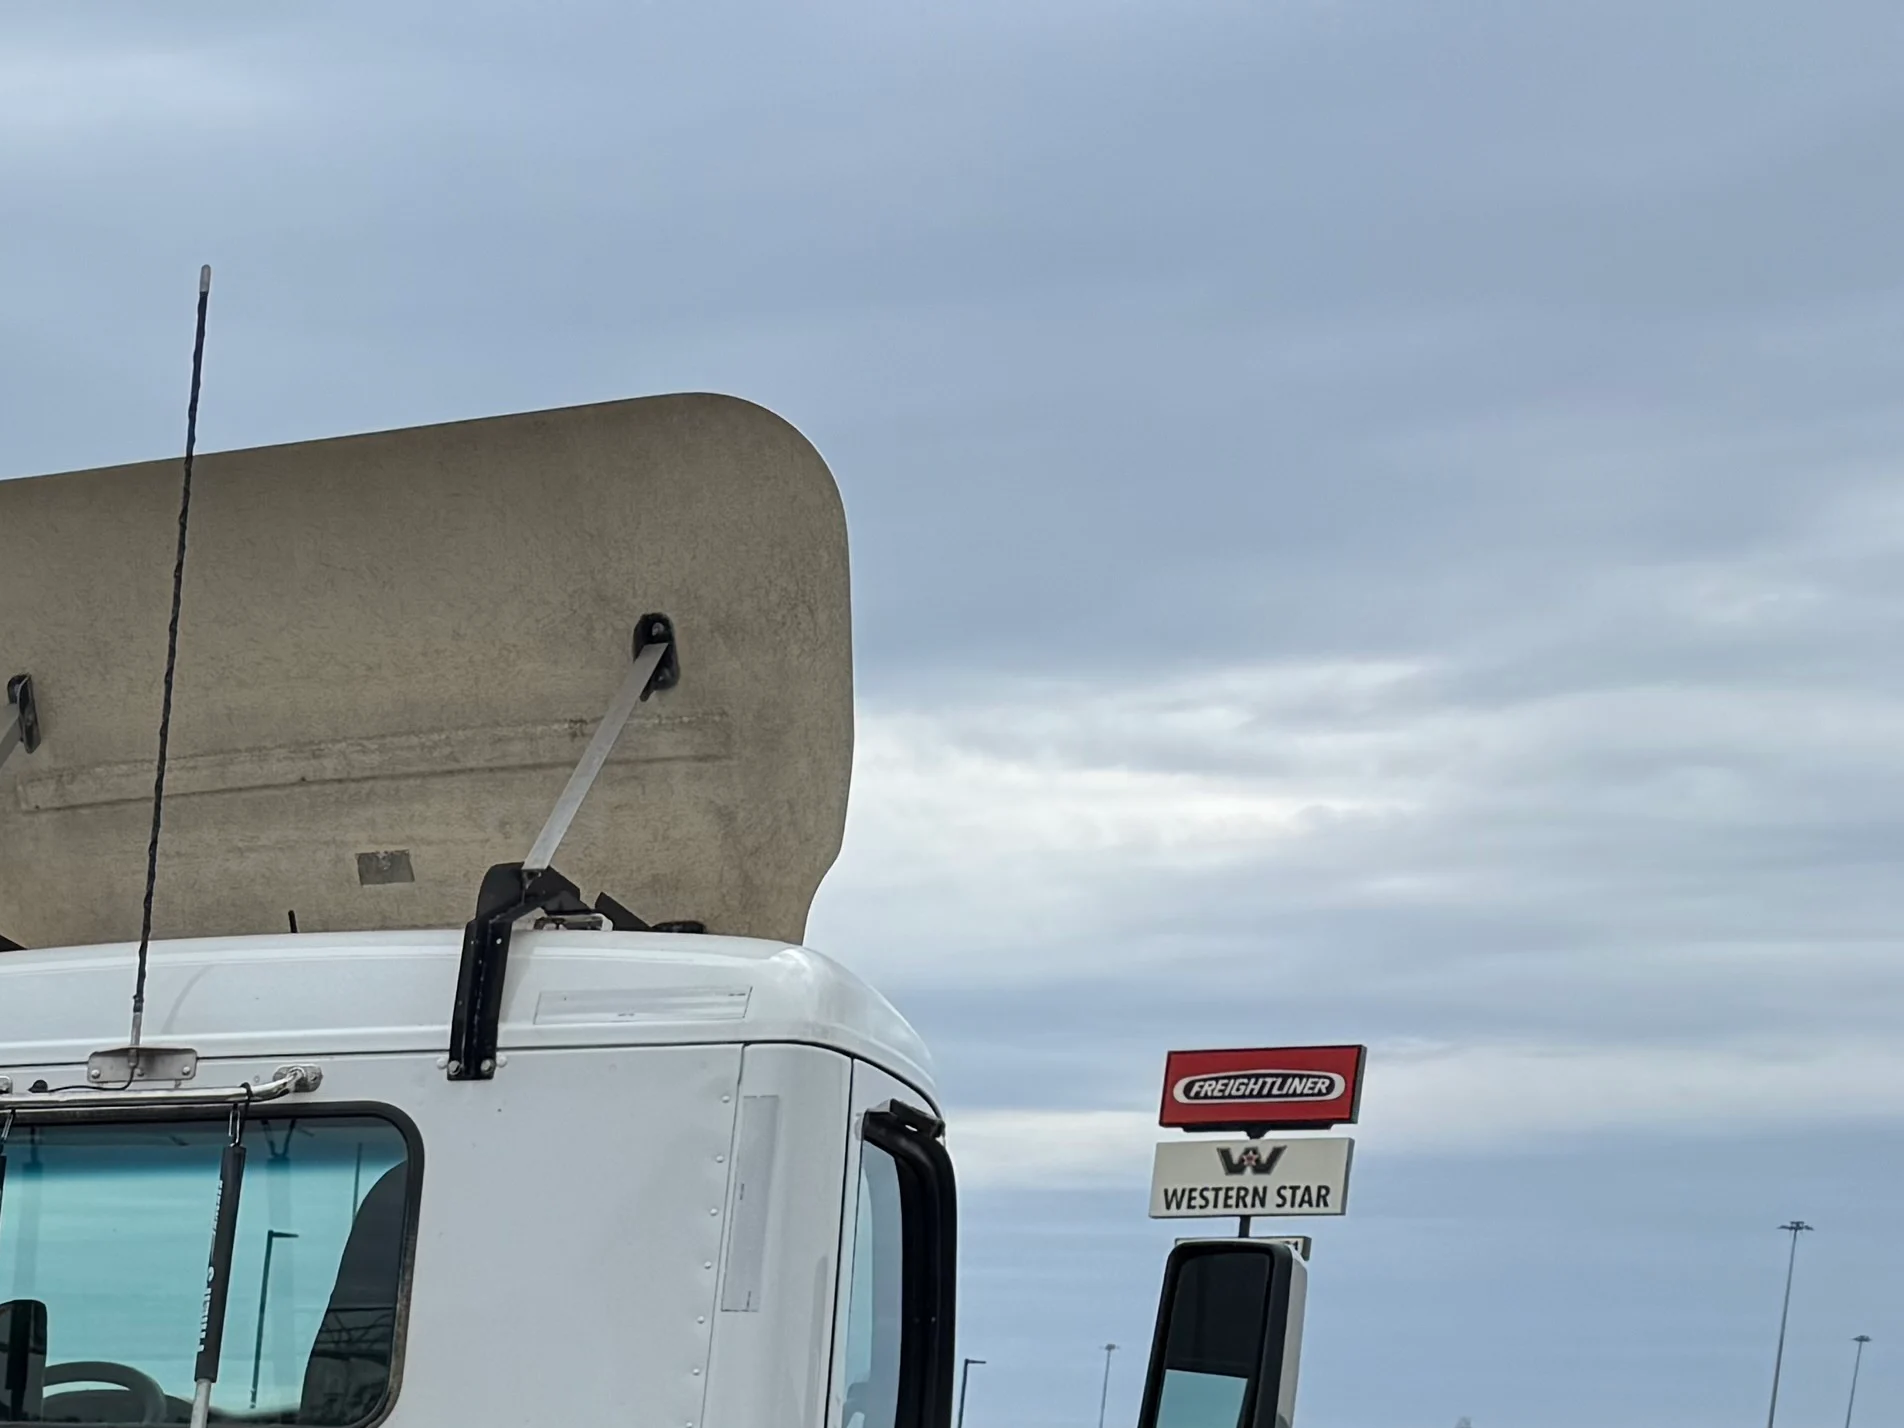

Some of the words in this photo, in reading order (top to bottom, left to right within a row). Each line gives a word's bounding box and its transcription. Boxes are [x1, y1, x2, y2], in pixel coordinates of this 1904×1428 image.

[1189, 1077, 1330, 1098] FREIGHTLINER
[1163, 1186, 1268, 1210] WESTERN
[1276, 1185, 1331, 1208] STAR
